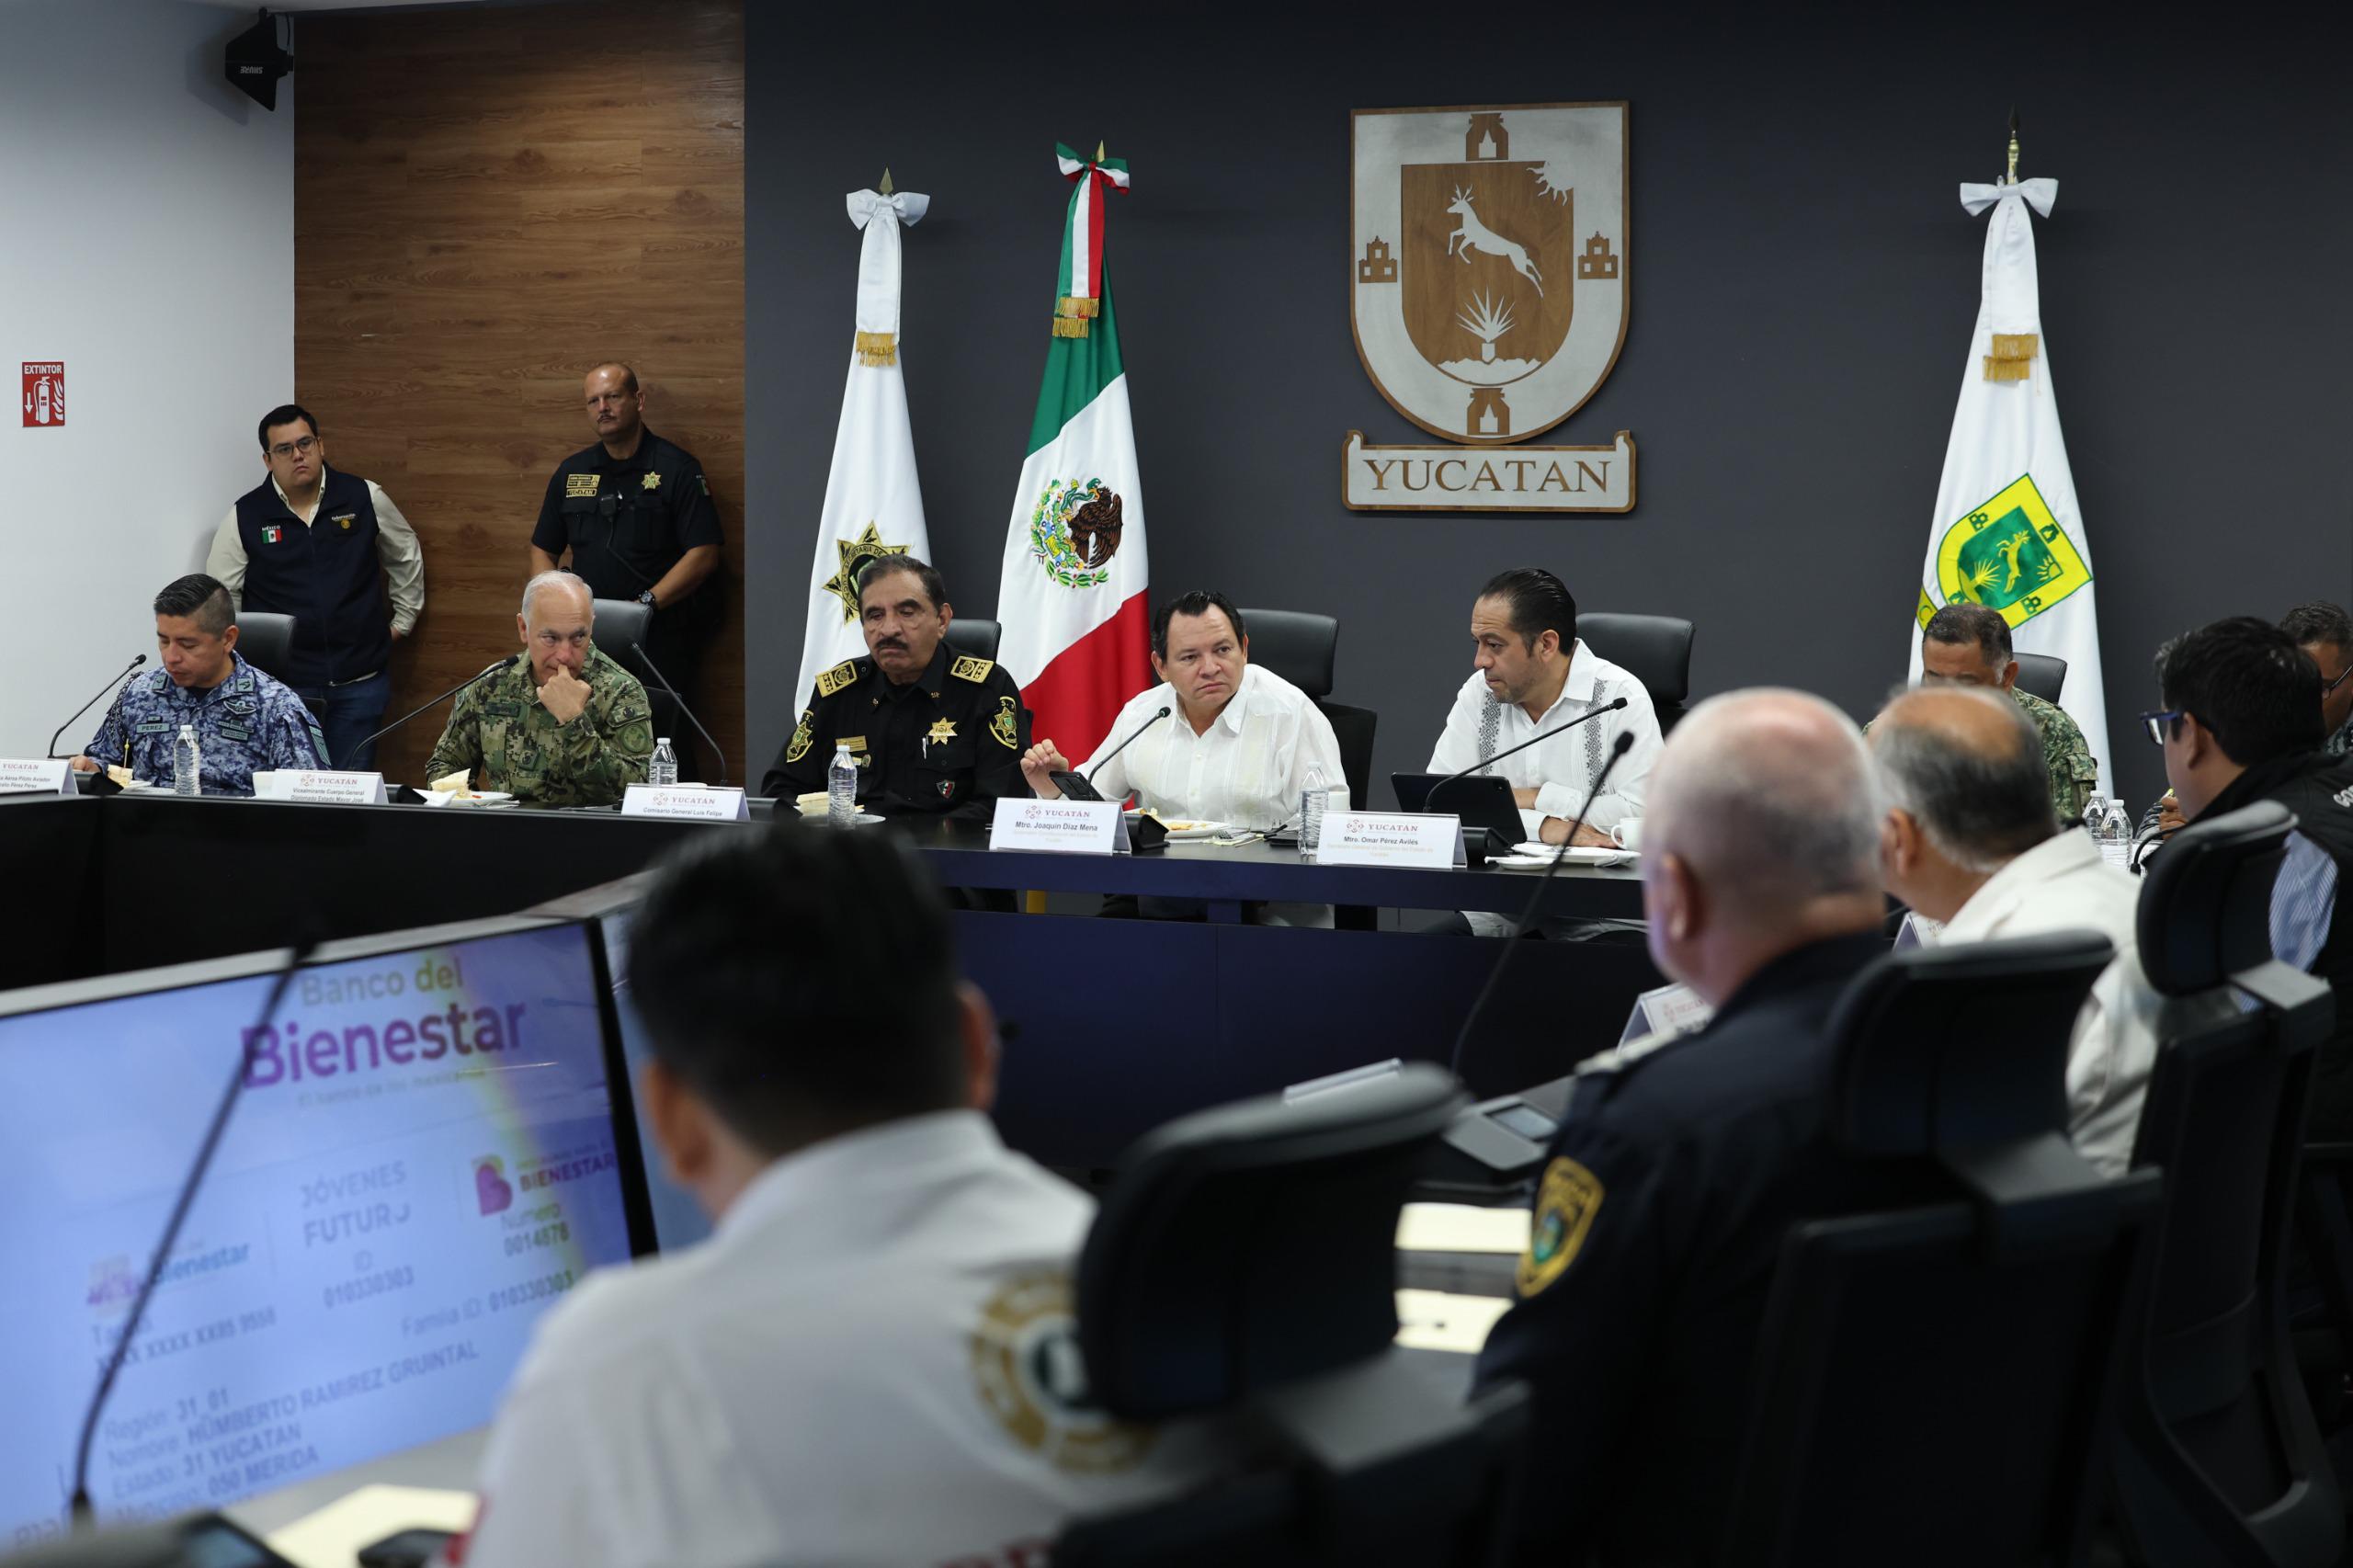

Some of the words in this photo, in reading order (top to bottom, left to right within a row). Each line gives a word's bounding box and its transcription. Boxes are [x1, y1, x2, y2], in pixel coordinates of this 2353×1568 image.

[240, 66, 264, 74] SHURE
[24, 365, 63, 375] EXTINTOR
[1362, 459, 1611, 494] YUCATAN
[301, 970, 405, 1007] Banco
[415, 958, 464, 994] del
[240, 1001, 527, 1089] Bienestar
[519, 1153, 619, 1193] BIENESTAR
